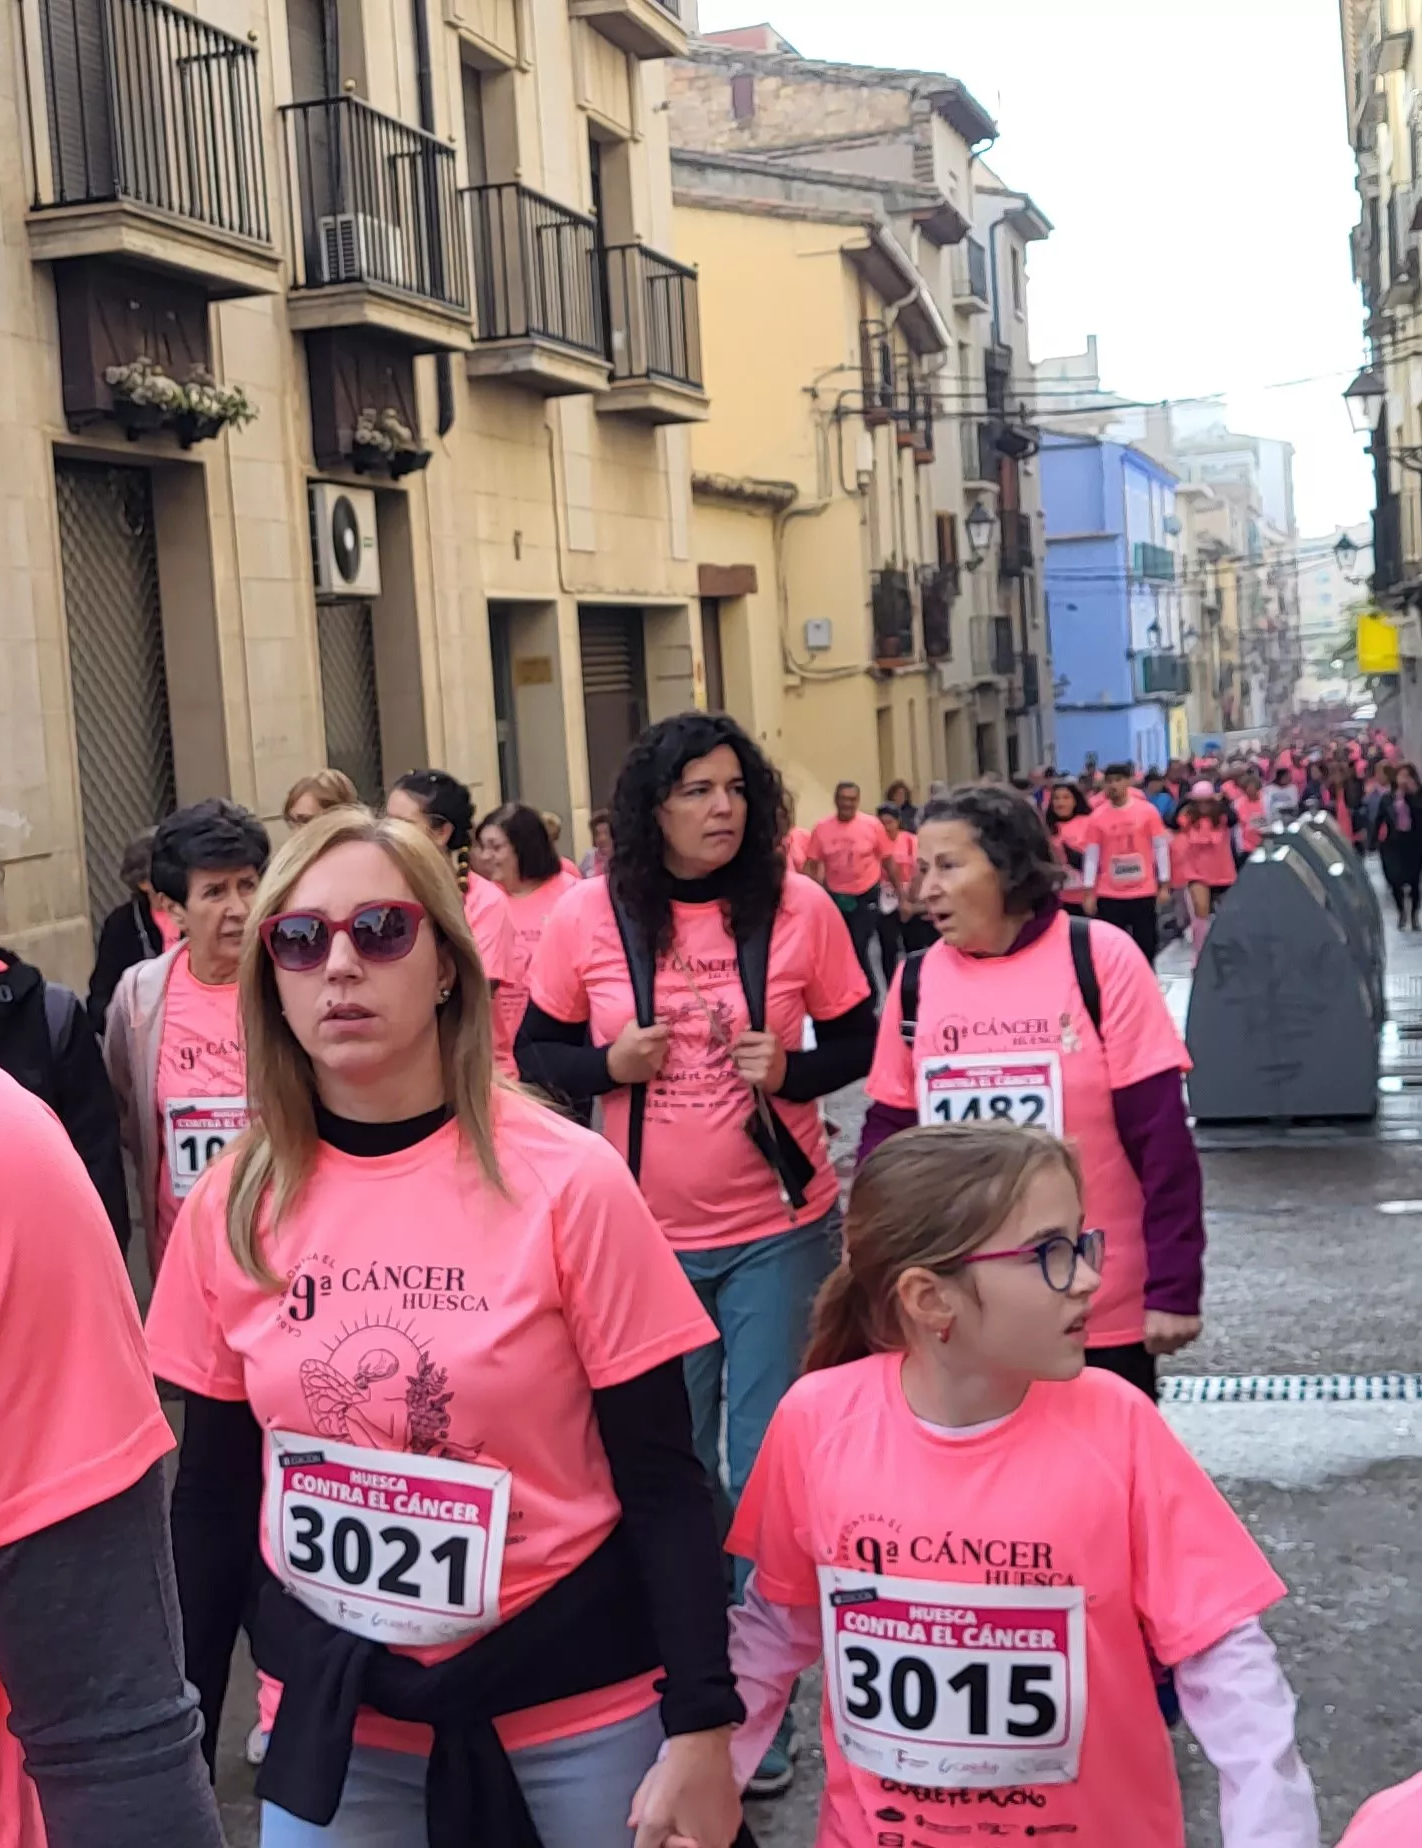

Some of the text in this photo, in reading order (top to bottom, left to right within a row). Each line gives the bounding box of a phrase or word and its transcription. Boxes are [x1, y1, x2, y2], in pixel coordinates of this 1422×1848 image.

[973, 1018, 1048, 1036] CÁNCER
[934, 1094, 1045, 1129] 1482
[342, 1261, 466, 1292] CÁNCER
[401, 1293, 489, 1312] HUESCA
[291, 1472, 479, 1523] CONTRA EL CÁNCER
[349, 1470, 407, 1493] HUESCA
[288, 1505, 469, 1605] 3021
[910, 1532, 1053, 1569] CÁNCER
[843, 1611, 1057, 1649] CONTRA EL CÁNCER
[909, 1605, 977, 1625] HUESCA
[844, 1646, 1058, 1738] 3015
